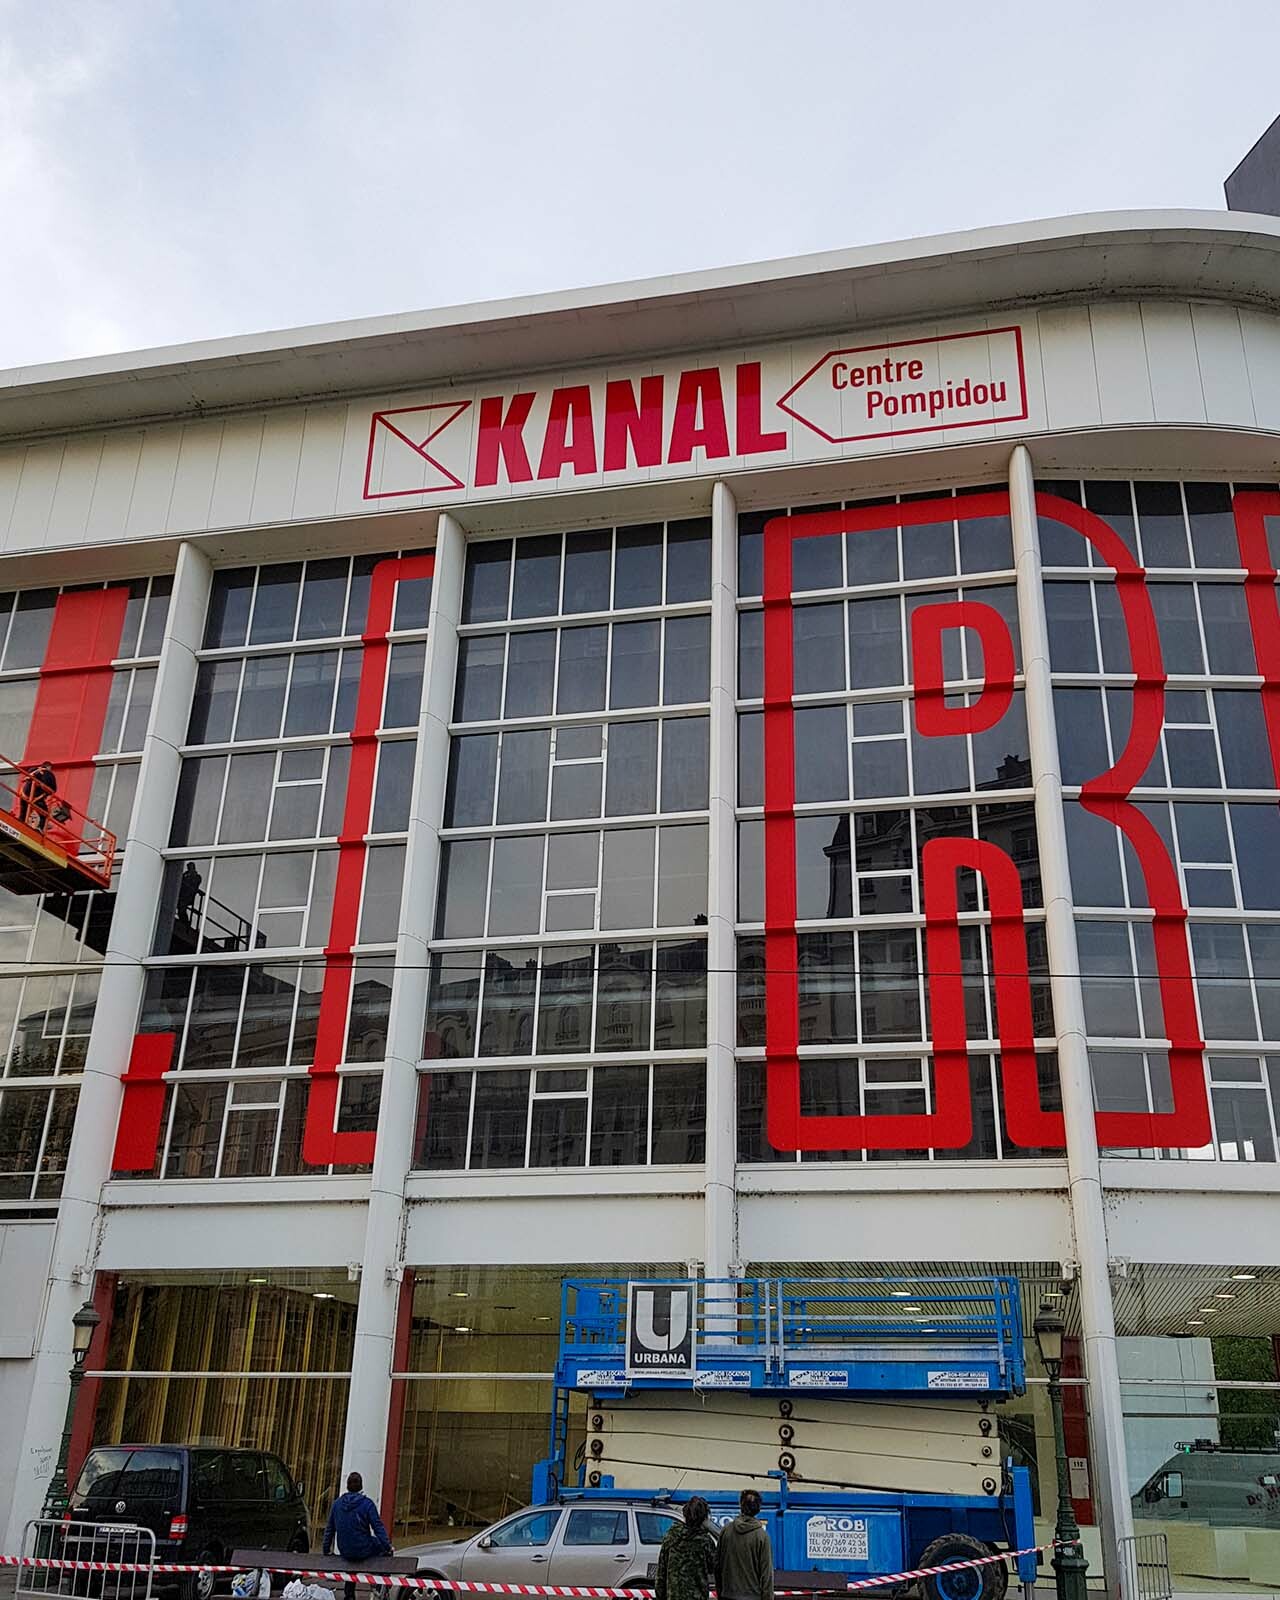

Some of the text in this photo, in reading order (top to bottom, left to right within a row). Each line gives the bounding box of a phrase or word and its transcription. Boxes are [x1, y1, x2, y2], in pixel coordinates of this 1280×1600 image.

[831, 356, 923, 390] Centre
[866, 377, 1006, 419] Pompidou
[474, 361, 787, 488] KANAL
[634, 1352, 687, 1364] URBANA
[826, 1518, 865, 1531] ROB
